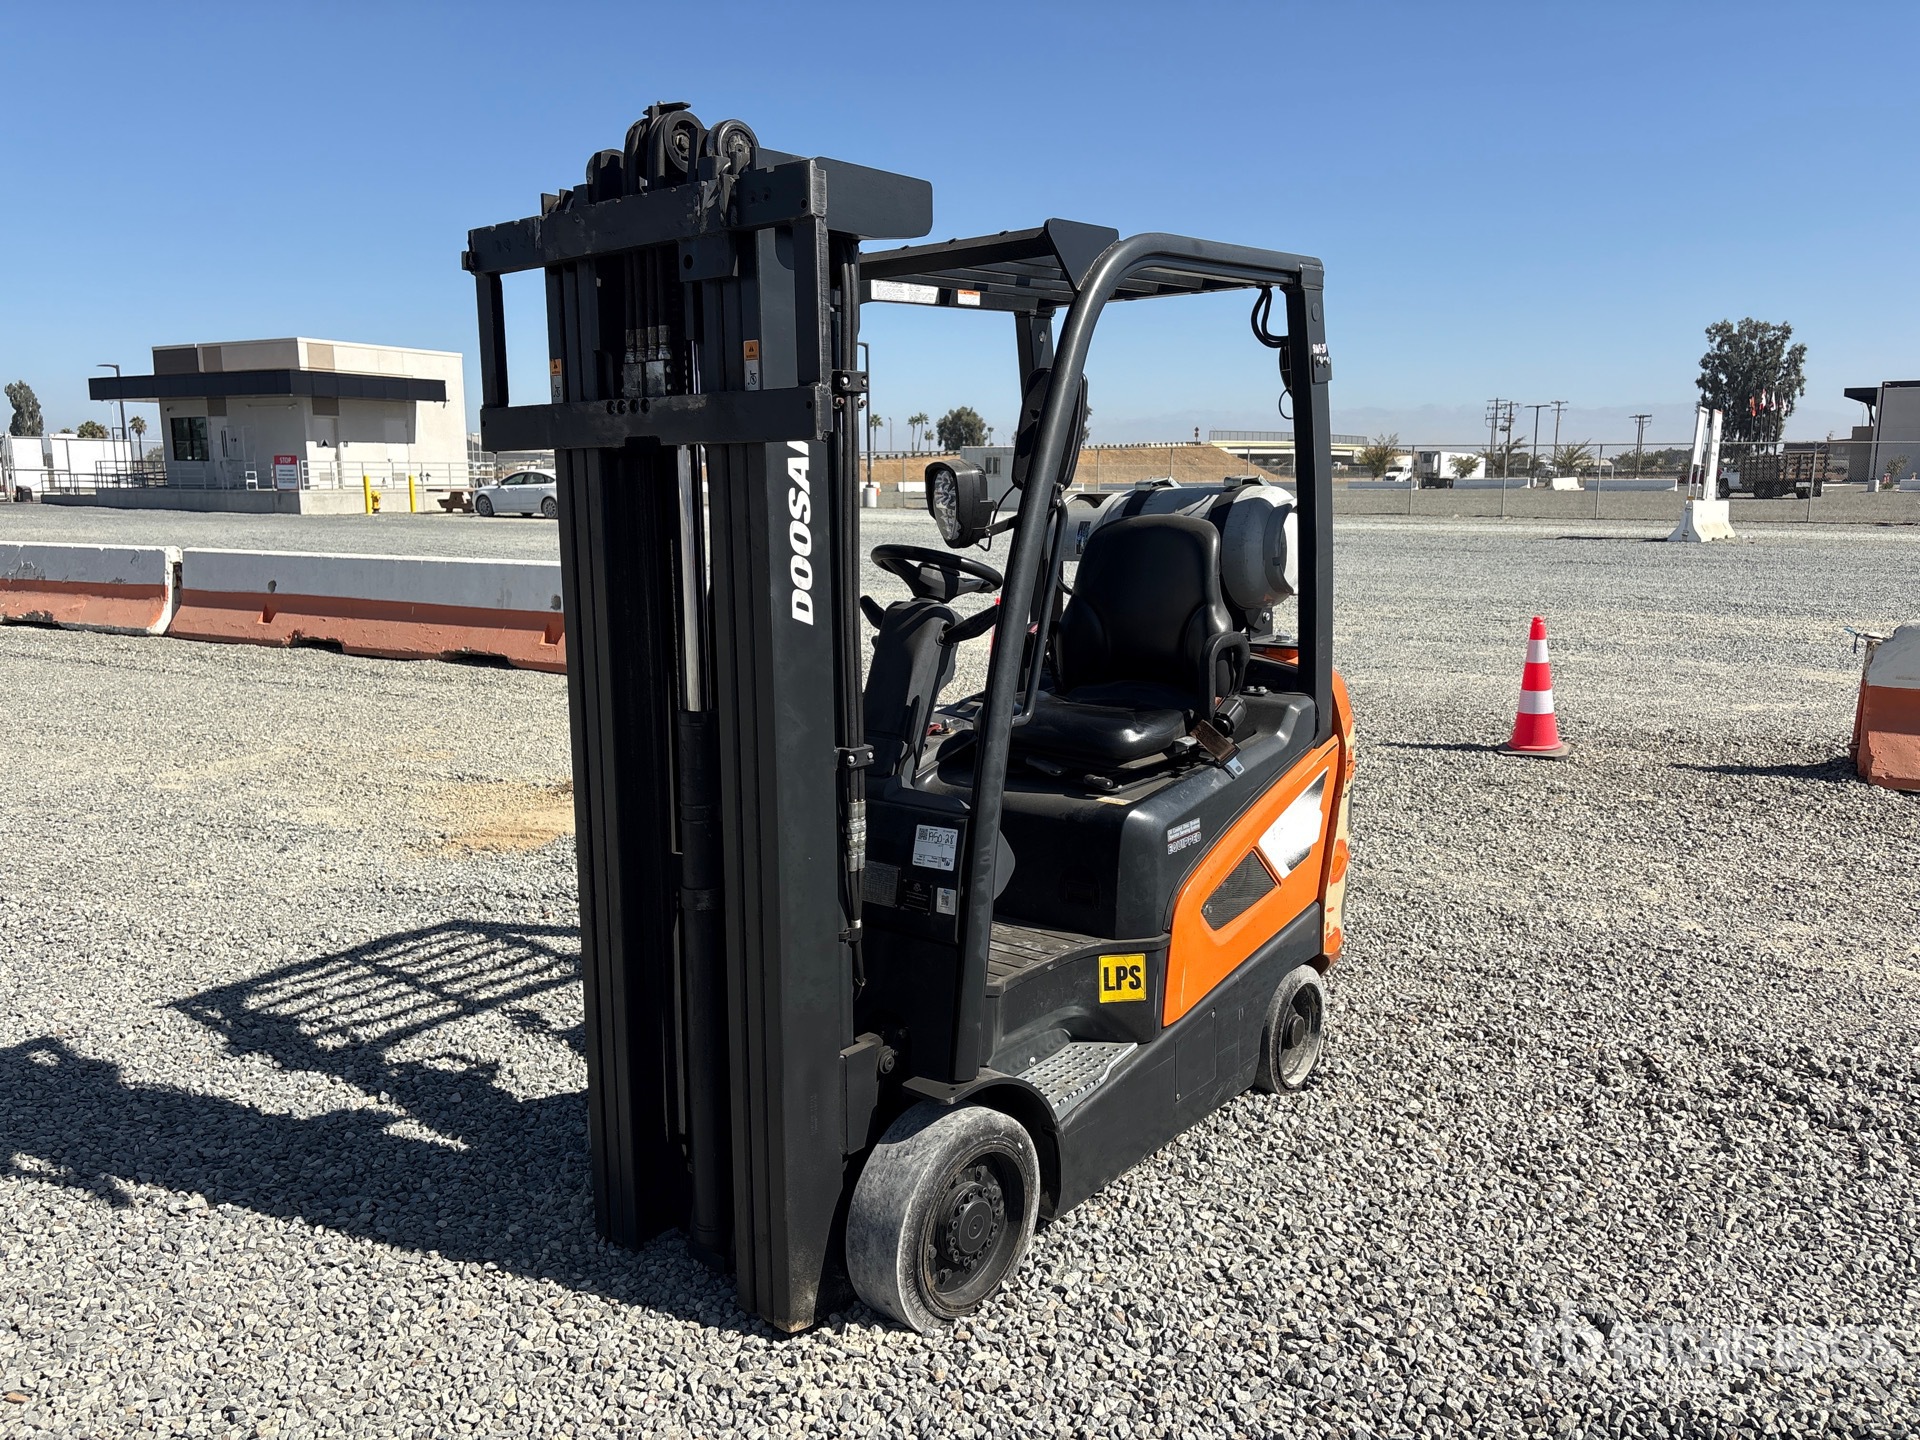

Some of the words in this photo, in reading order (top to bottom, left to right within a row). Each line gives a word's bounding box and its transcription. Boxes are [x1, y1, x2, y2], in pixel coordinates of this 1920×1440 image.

[279, 456, 292, 464] STOP
[1167, 831, 1201, 855] EQUIPPED
[1103, 965, 1142, 991] LPS
